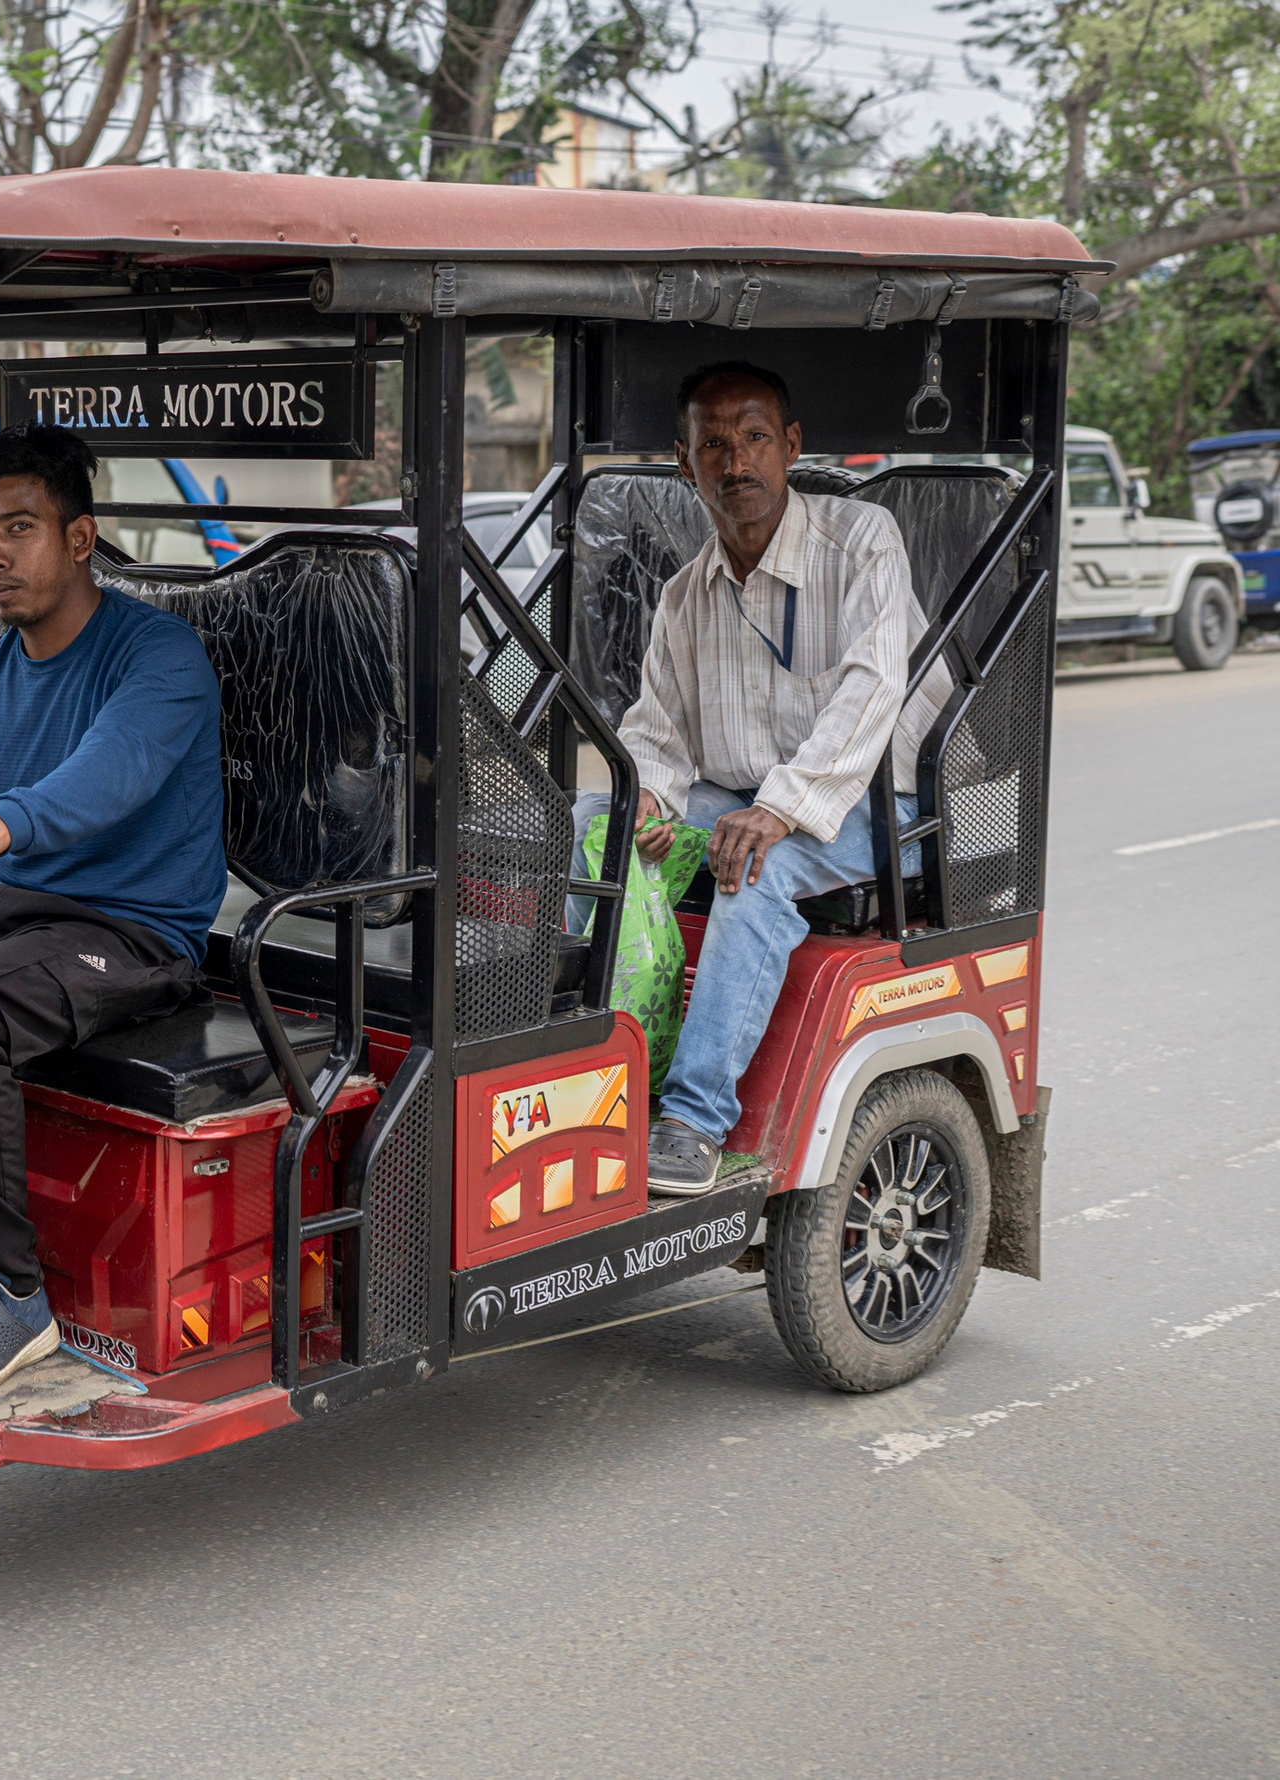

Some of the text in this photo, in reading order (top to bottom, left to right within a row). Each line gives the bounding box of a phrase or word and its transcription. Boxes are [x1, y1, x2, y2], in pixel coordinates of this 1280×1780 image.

[28, 380, 325, 428] TERRA MOTORS
[220, 757, 253, 781] ORS
[78, 954, 107, 973] adidas
[877, 975, 946, 1004] TERRA MOTORS
[501, 1091, 551, 1137] Y4A
[509, 1211, 747, 1315] TERRA MOTORS
